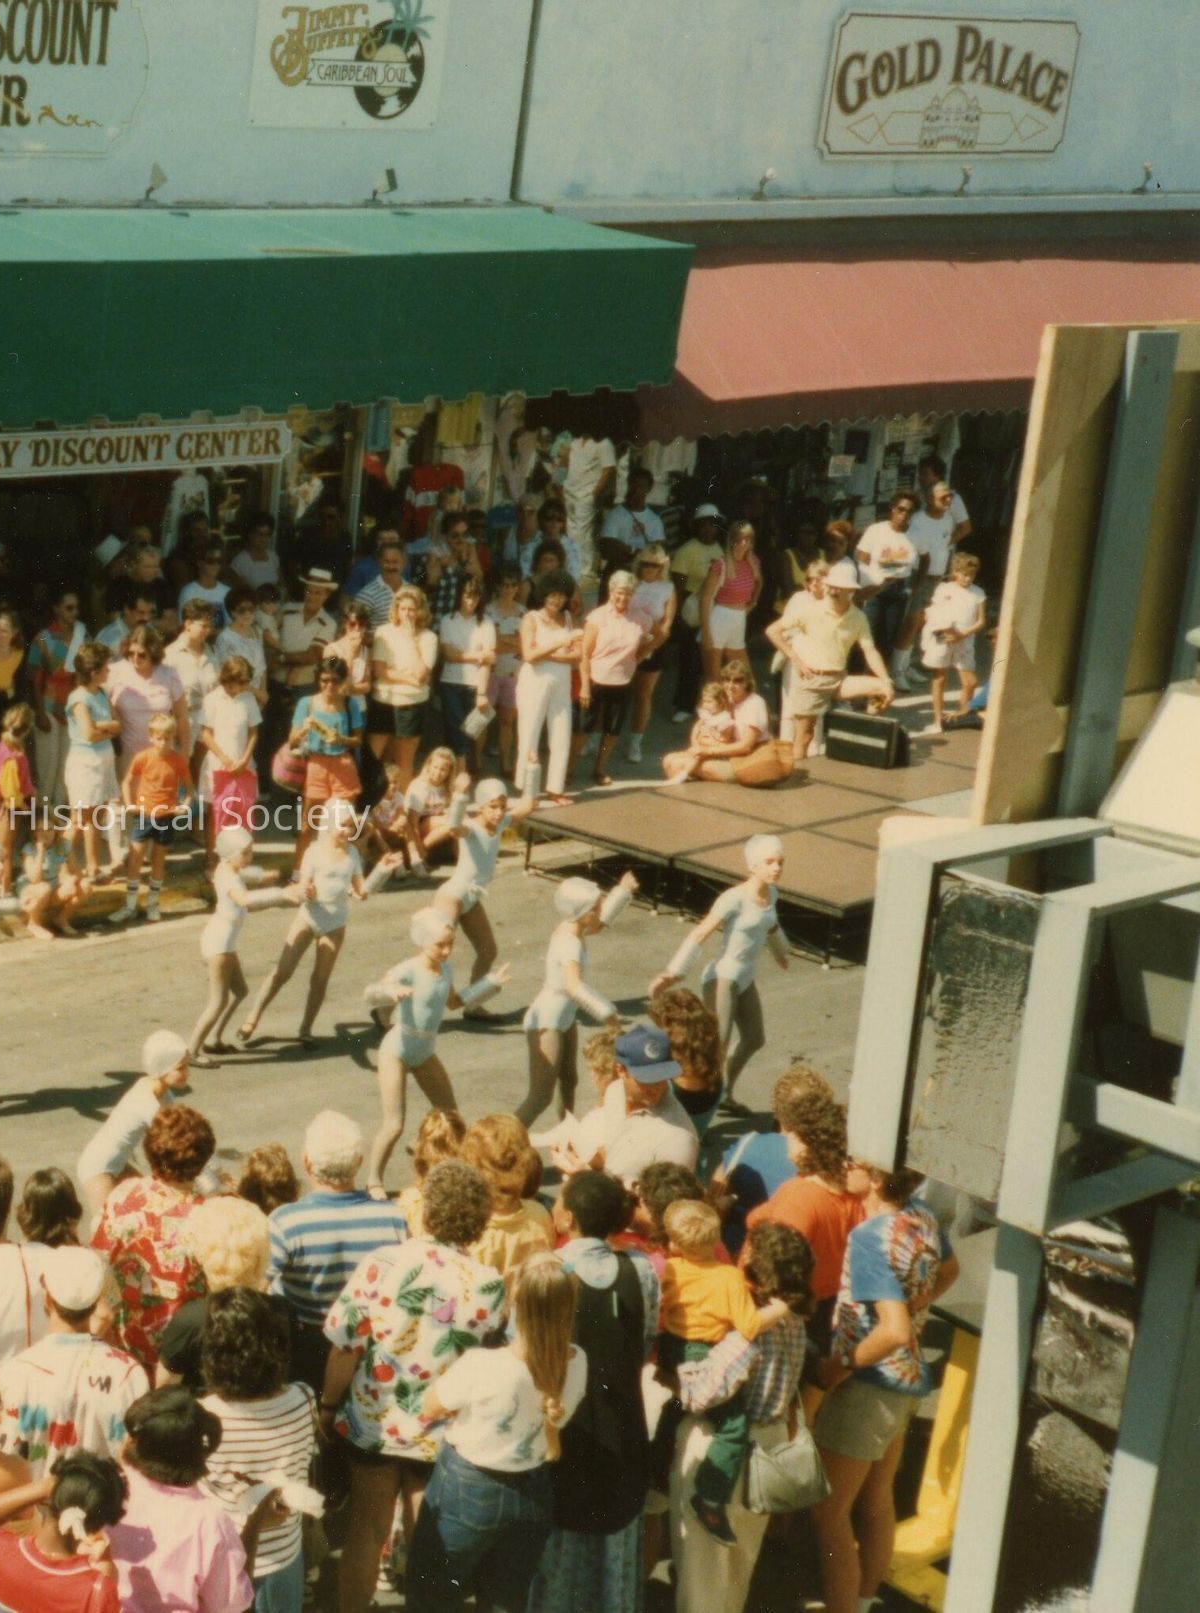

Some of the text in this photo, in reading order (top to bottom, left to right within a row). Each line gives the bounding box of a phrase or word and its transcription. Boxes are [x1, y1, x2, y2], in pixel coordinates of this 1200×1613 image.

[316, 63, 378, 82] CARIBBEAN
[834, 25, 1070, 116] GOLD PALACE
[28, 433, 171, 468] DISCOUNT
[175, 427, 282, 462] CENTER
